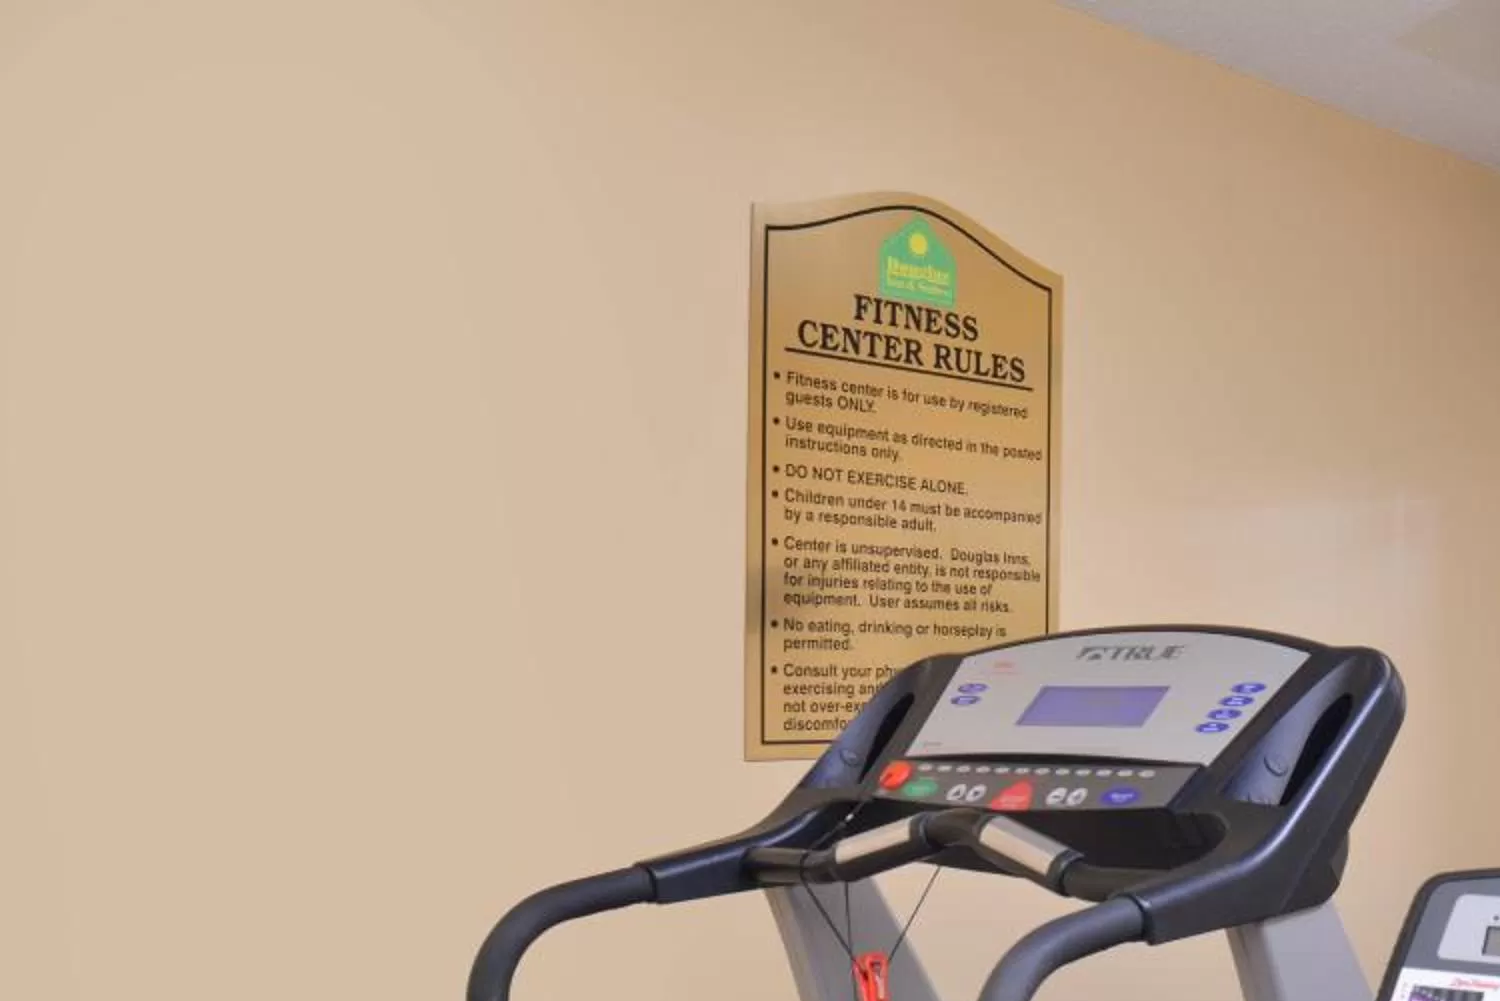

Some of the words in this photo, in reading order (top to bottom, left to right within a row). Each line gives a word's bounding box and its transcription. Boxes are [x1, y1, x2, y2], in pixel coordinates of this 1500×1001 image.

[853, 293, 979, 342] FITNESS
[798, 319, 924, 370] CENTER
[933, 343, 1026, 383] RULES
[786, 391, 832, 408] guests
[837, 395, 877, 413] ONLY.
[787, 371, 837, 391] Fitness
[841, 382, 884, 398] center
[887, 386, 899, 400] is
[902, 388, 919, 403] for
[923, 394, 946, 407] use
[950, 396, 965, 412] by
[968, 399, 1028, 419] registered
[785, 434, 867, 457] instructions
[786, 416, 812, 432] Use
[817, 422, 888, 442] equipment
[893, 432, 908, 445] as
[911, 433, 962, 451] directed
[966, 440, 977, 452] in
[980, 441, 999, 457] the
[1003, 447, 1042, 461] posted
[785, 463, 808, 479] DO
[812, 466, 844, 482] NOT
[847, 469, 917, 491] EXERCISE
[920, 479, 968, 496] ALONE.
[785, 487, 845, 508] Children
[848, 496, 887, 511] under
[910, 502, 941, 516] must
[945, 504, 961, 518] be
[963, 507, 1042, 525] accompanied
[784, 507, 801, 525] by
[805, 511, 814, 521] a
[818, 511, 897, 529] responsible
[901, 517, 936, 533] adult.
[784, 535, 831, 552] Center
[835, 539, 847, 553] is
[851, 543, 942, 559] unsupervised.
[951, 547, 1000, 566] Douglas
[784, 557, 799, 569] or
[803, 557, 828, 572] any
[832, 557, 890, 573] affiliated
[935, 564, 947, 576] is
[950, 566, 970, 579] not
[972, 567, 1041, 582] responsible
[784, 571, 803, 586] for
[807, 574, 859, 590] injuries
[863, 576, 912, 595] relating
[915, 580, 929, 593] to
[931, 580, 951, 594] the
[954, 584, 976, 596] use
[979, 583, 993, 596] of
[784, 593, 861, 608] equipment.
[869, 594, 901, 608] User
[903, 598, 960, 611] assumes
[963, 599, 977, 612] all
[980, 599, 1014, 613] risks.
[784, 617, 804, 632] No
[807, 619, 855, 637] eating,
[858, 620, 913, 638] drinking
[915, 624, 930, 635] or
[933, 623, 992, 640] horseplay
[995, 624, 1007, 638] is
[784, 663, 838, 678] Consult
[841, 666, 873, 681] your
[784, 683, 855, 699] exercising
[784, 700, 806, 713] not
[784, 717, 849, 732] discomfo
